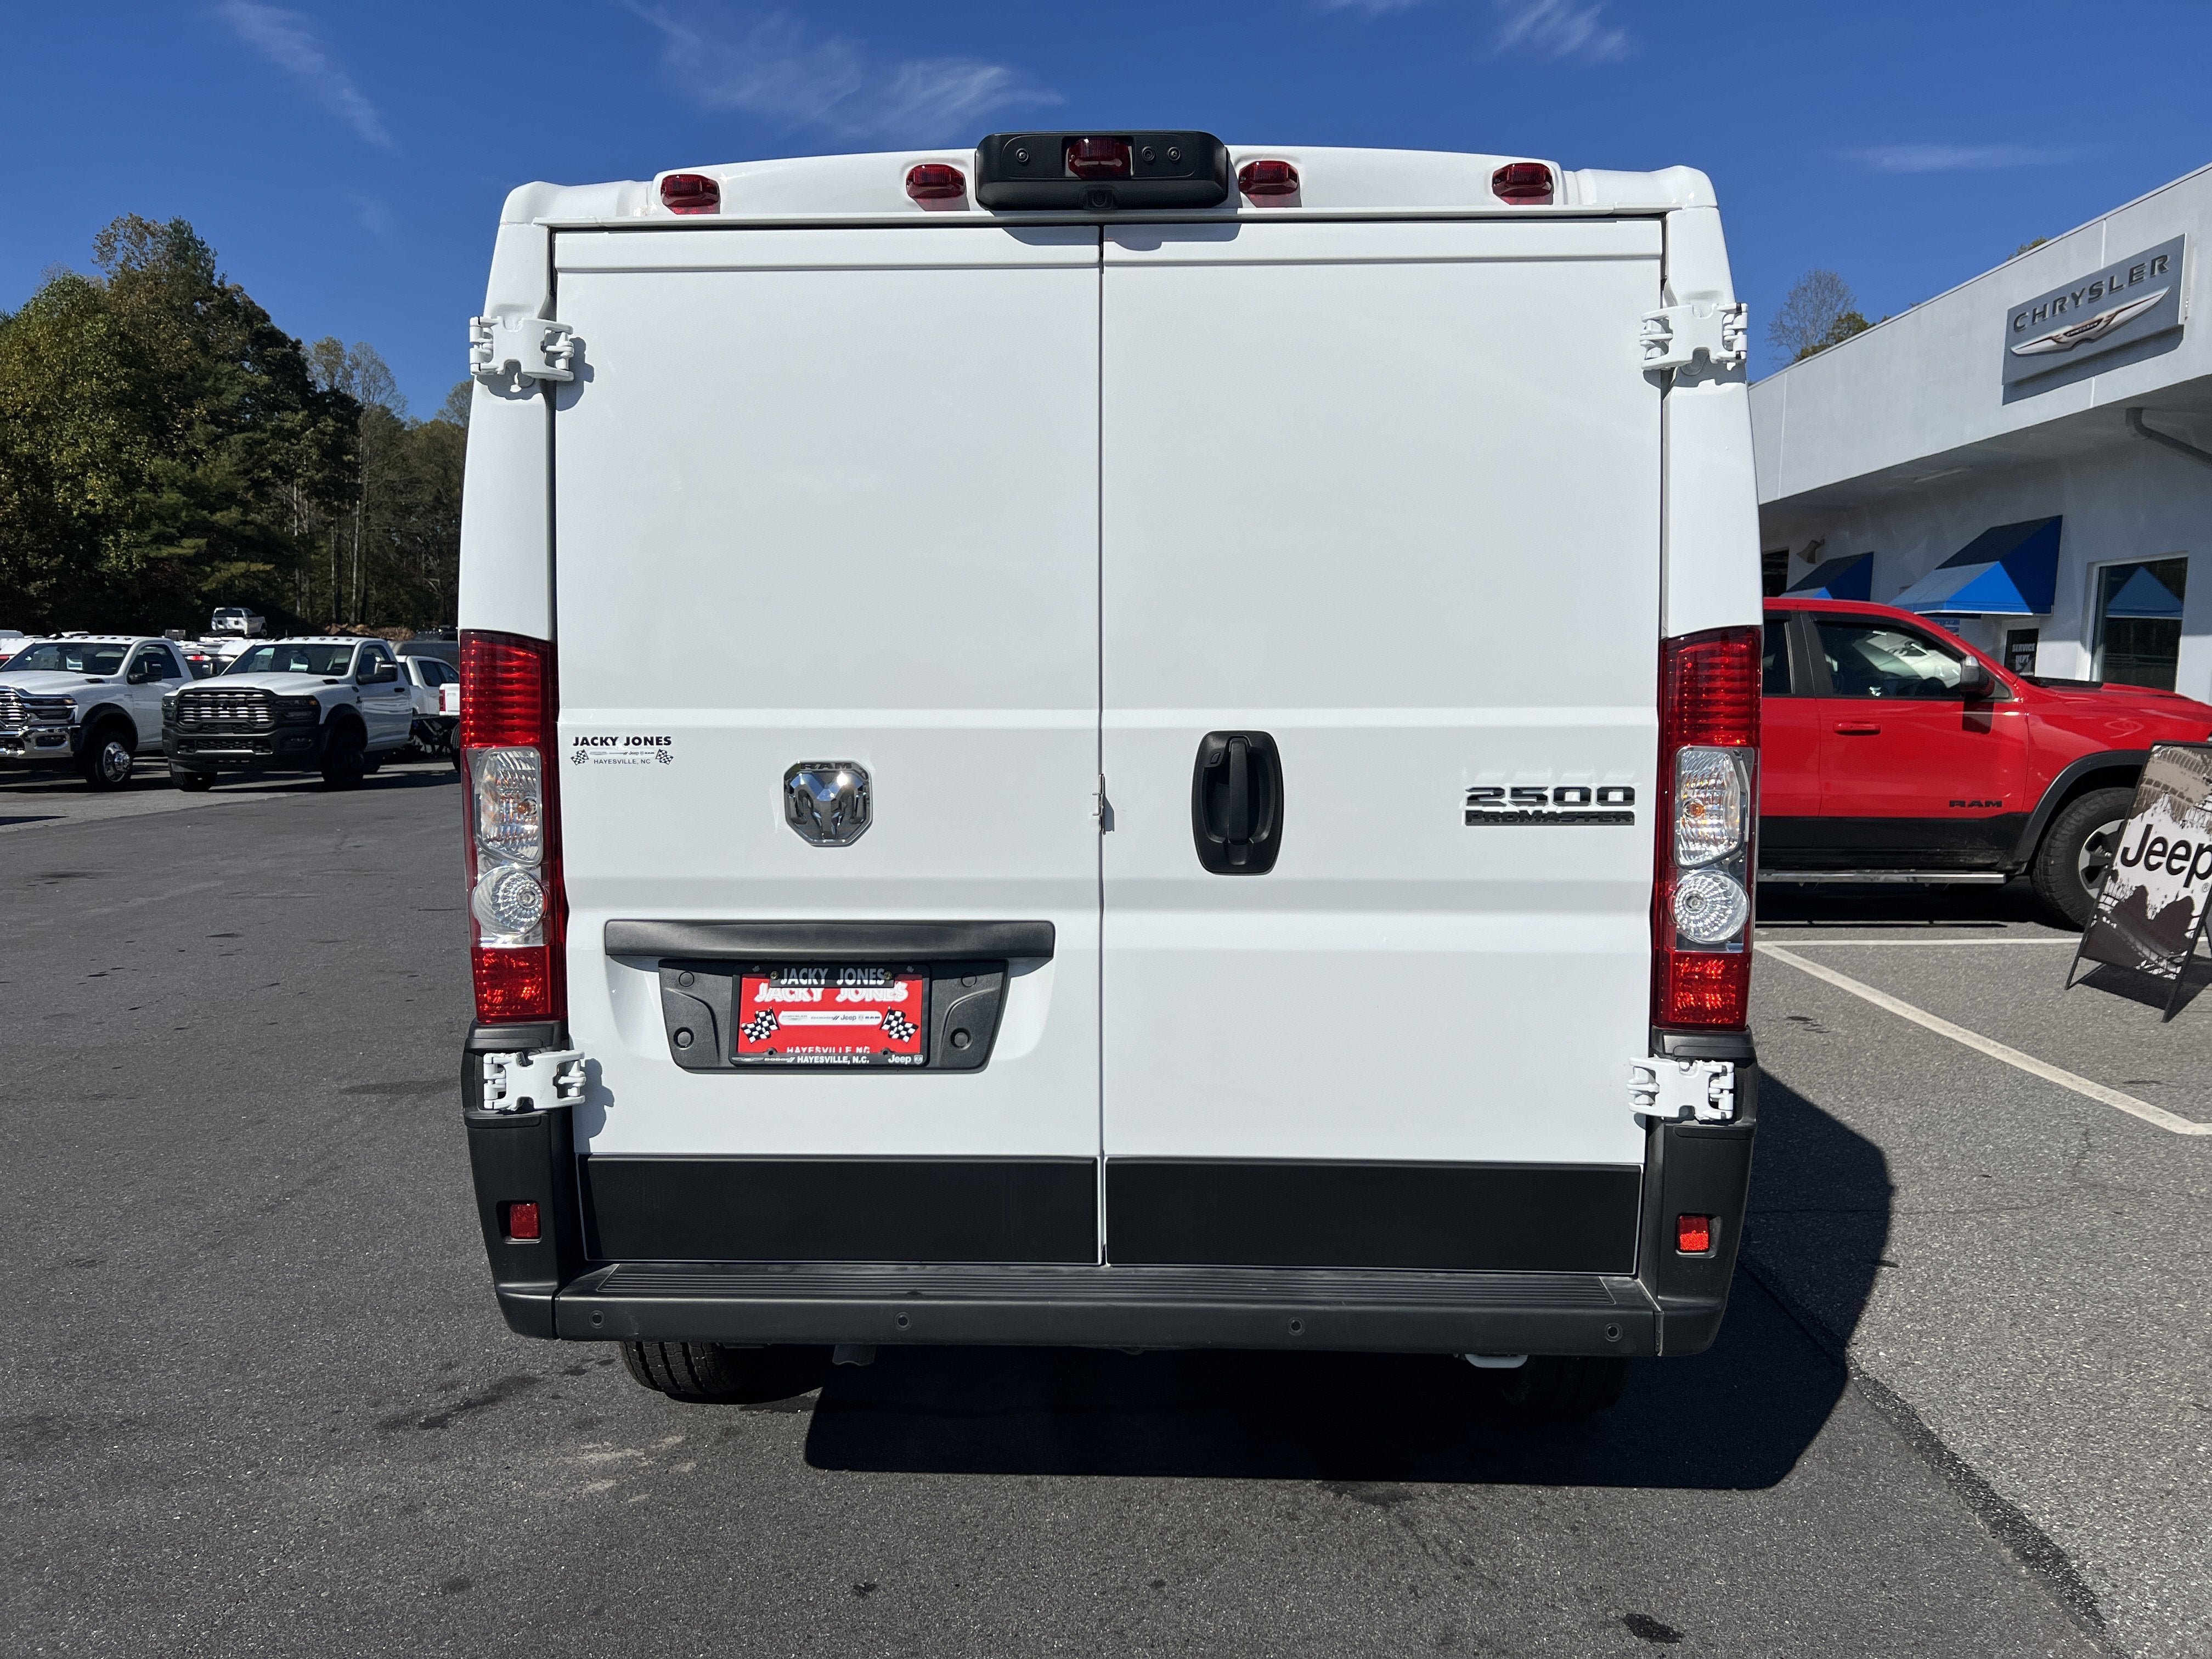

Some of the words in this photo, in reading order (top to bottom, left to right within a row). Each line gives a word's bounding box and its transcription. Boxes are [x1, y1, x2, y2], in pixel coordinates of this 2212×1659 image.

[2013, 255, 2170, 330] CHRYSLER
[2012, 642, 2035, 652] SERVICE
[573, 736, 619, 746] JACKY
[623, 736, 672, 746] JONES
[1465, 786, 1634, 806] 2500
[2120, 823, 2212, 888] Jeep
[780, 968, 829, 985] JACKY
[836, 968, 885, 985] JONES
[797, 1056, 850, 1064] HAYESVILLE,
[853, 1056, 870, 1064] N.C.
[888, 1054, 912, 1065] Jeep
